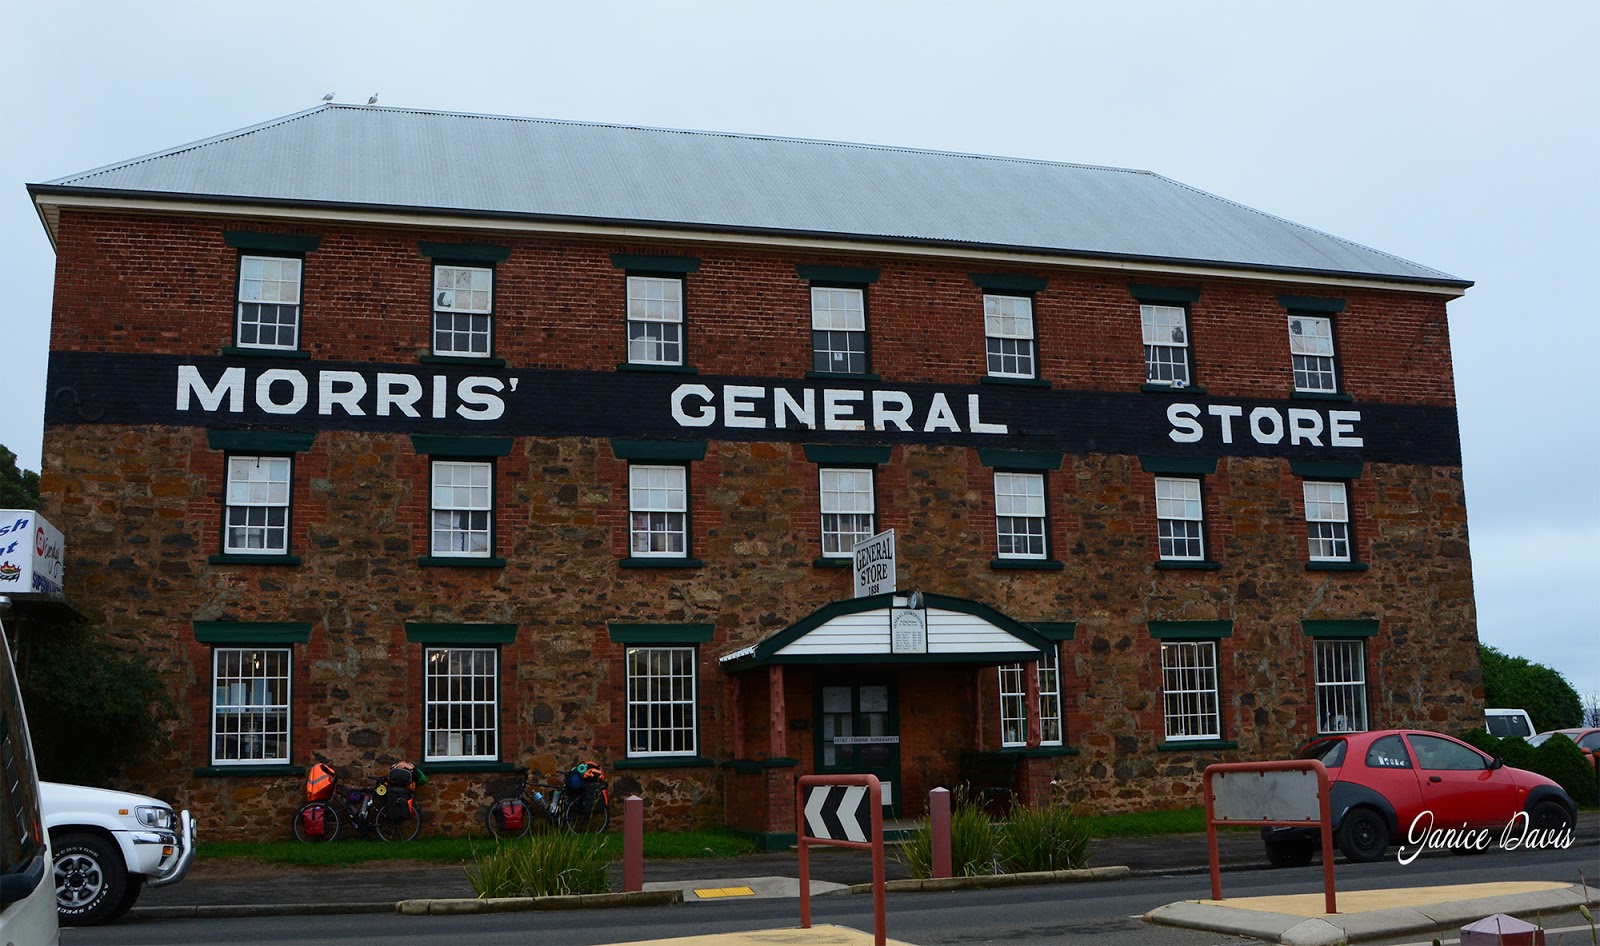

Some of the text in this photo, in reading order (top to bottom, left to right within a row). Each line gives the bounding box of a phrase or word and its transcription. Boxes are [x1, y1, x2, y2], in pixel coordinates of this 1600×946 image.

[176, 365, 1364, 447] MORRIS' GENERAL STORE
[856, 538, 892, 572] GENERAL
[860, 563, 888, 586] STORE
